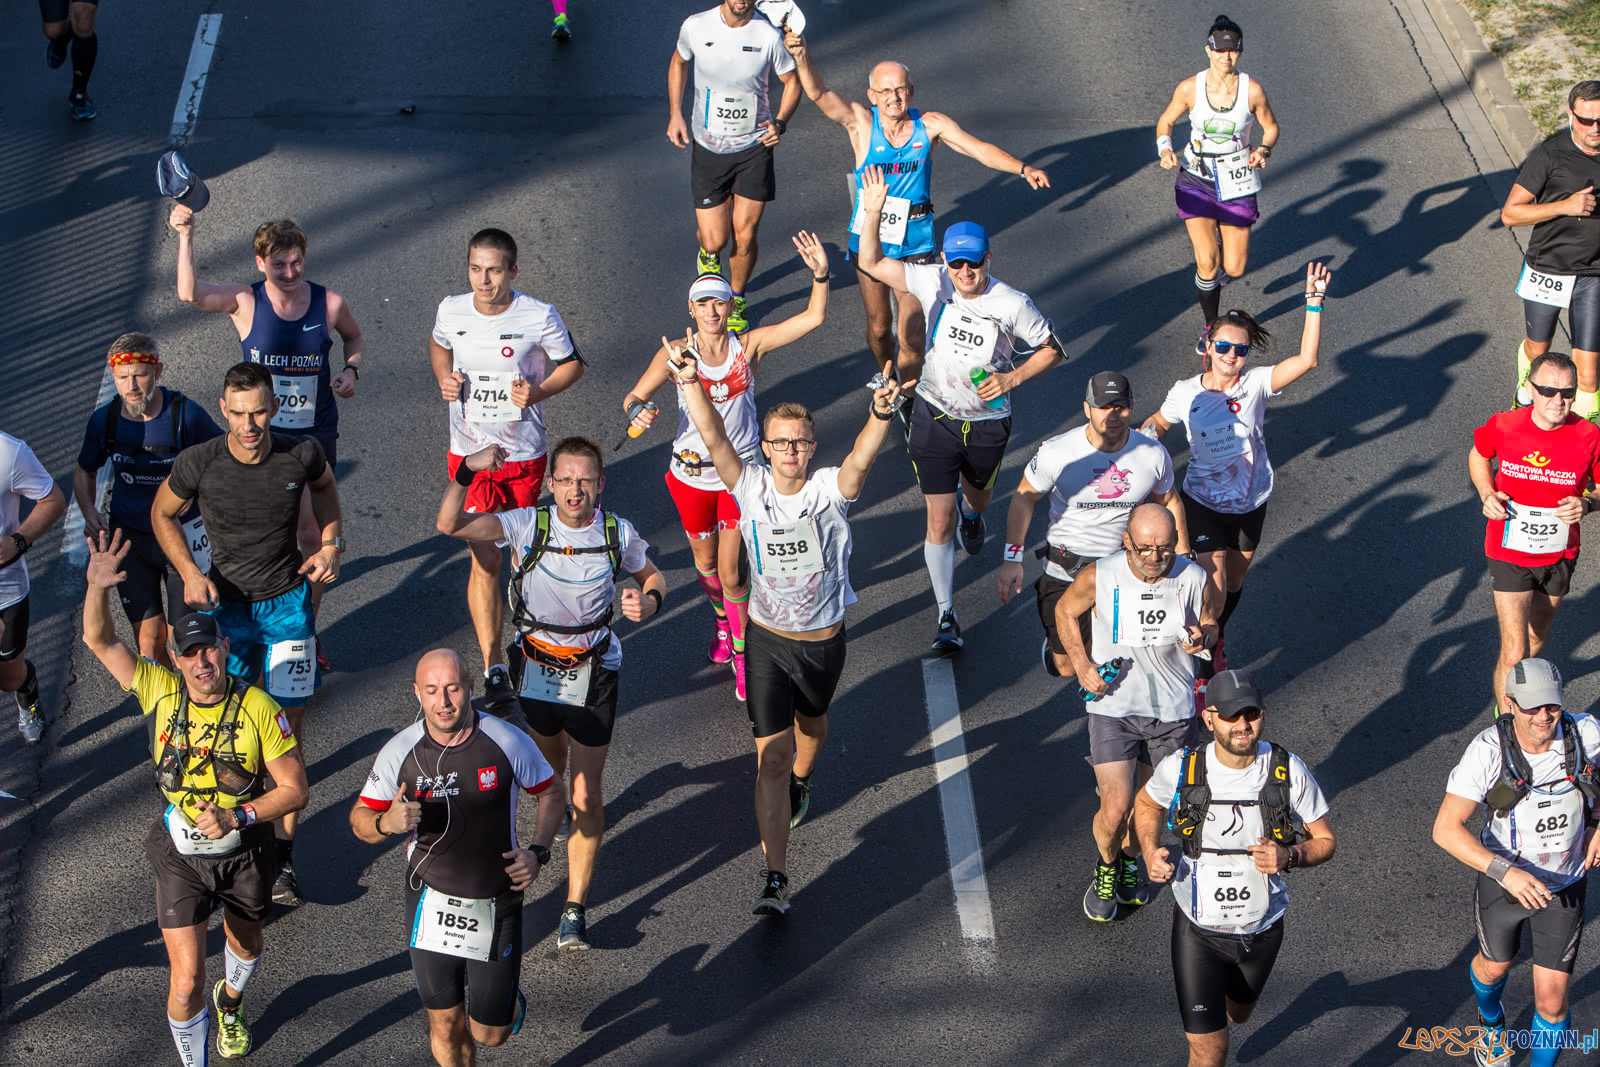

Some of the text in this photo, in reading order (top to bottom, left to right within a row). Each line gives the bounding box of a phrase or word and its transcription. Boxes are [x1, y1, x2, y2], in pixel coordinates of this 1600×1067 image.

[717, 107, 748, 119] 3202
[1530, 272, 1563, 291] 5708
[949, 326, 984, 347] 3510
[264, 355, 288, 366] LECH
[274, 394, 307, 407] 709
[473, 389, 508, 402] 4714
[1502, 460, 1576, 479] SPORTOWA PACZKA
[1529, 473, 1549, 482] GRUPA
[1520, 521, 1558, 535] 2523
[193, 534, 209, 552] 40
[767, 540, 808, 556] 5338
[1138, 610, 1167, 625] 169
[287, 660, 312, 675] 753
[539, 664, 578, 681] 1995
[1535, 813, 1568, 833] 682
[1214, 886, 1250, 902] 686
[436, 911, 479, 933] 1852
[444, 931, 465, 940] Andrzej
